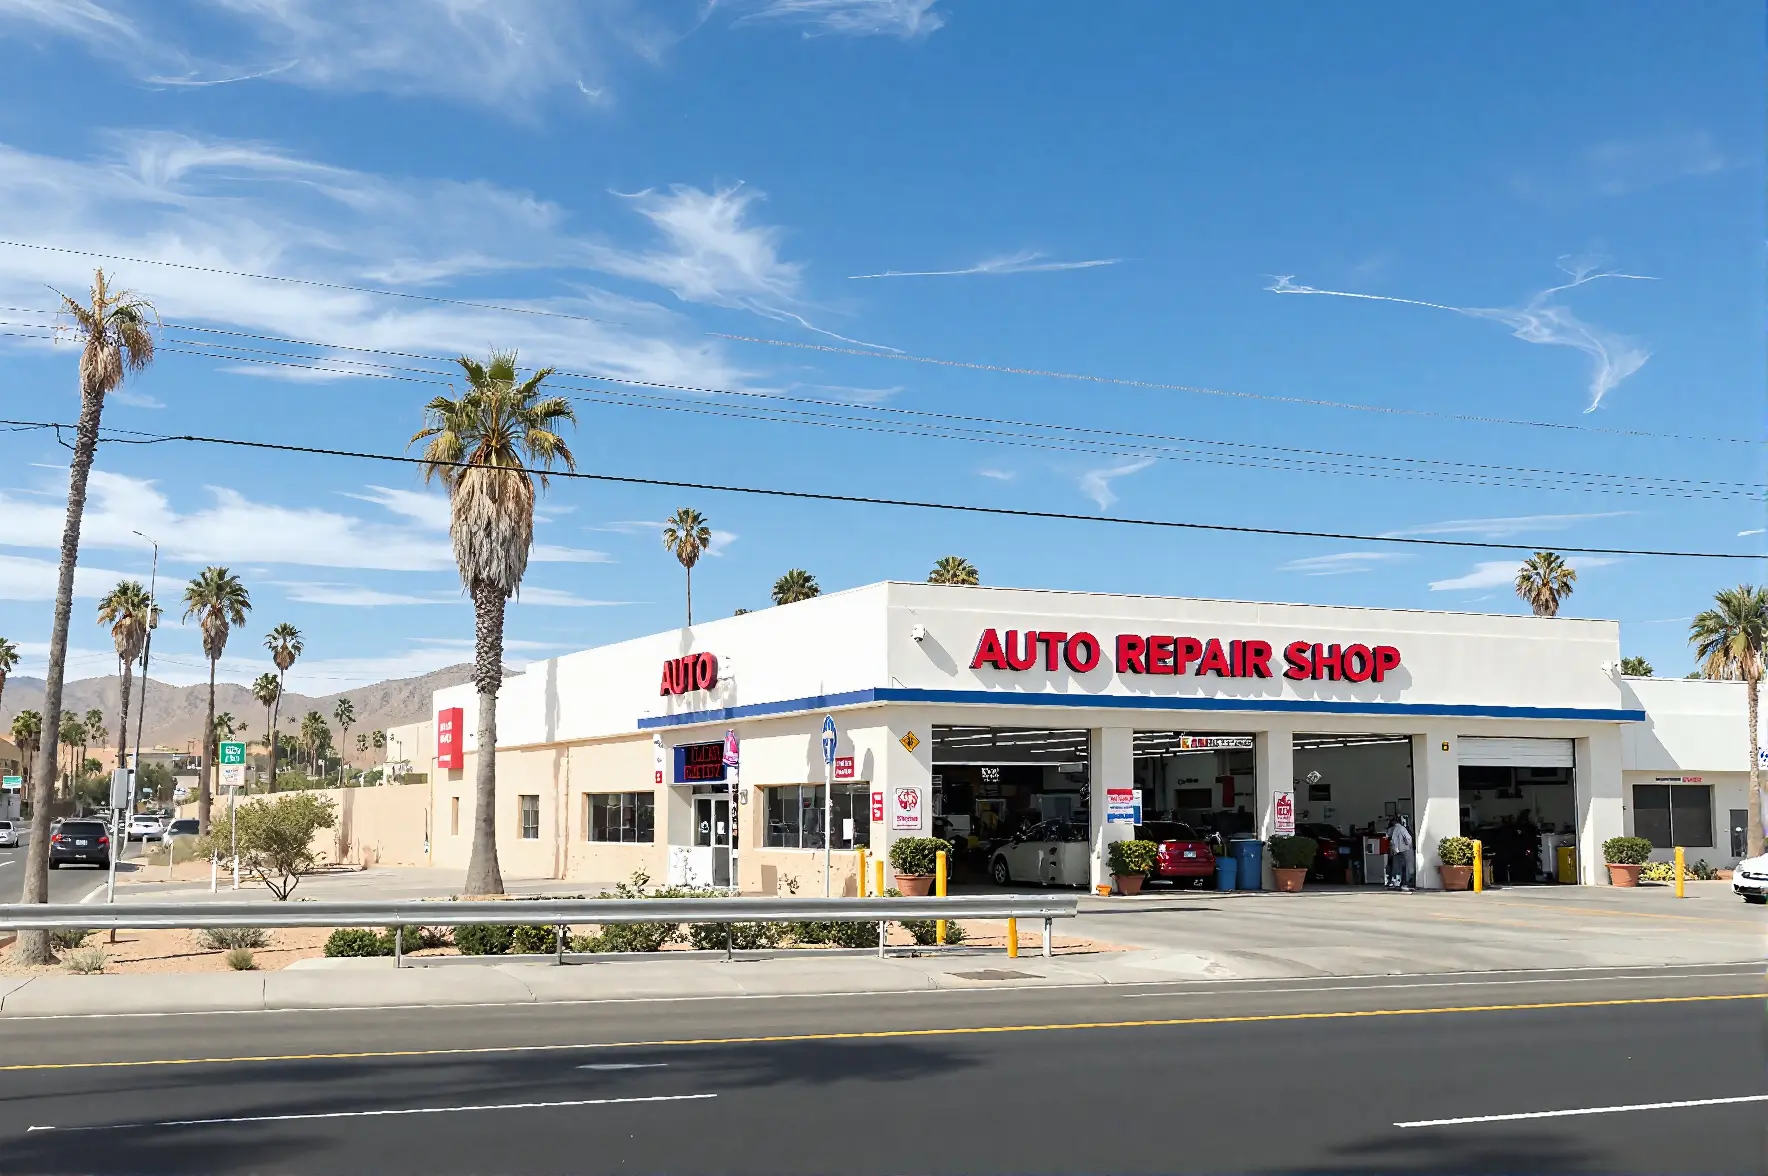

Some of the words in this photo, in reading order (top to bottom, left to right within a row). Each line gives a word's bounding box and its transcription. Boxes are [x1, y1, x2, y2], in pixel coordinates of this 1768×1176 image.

[660, 652, 718, 696] AUTO
[969, 628, 1101, 673] AUTO
[1115, 634, 1273, 679] REPAIR
[1282, 640, 1401, 683] SHOP
